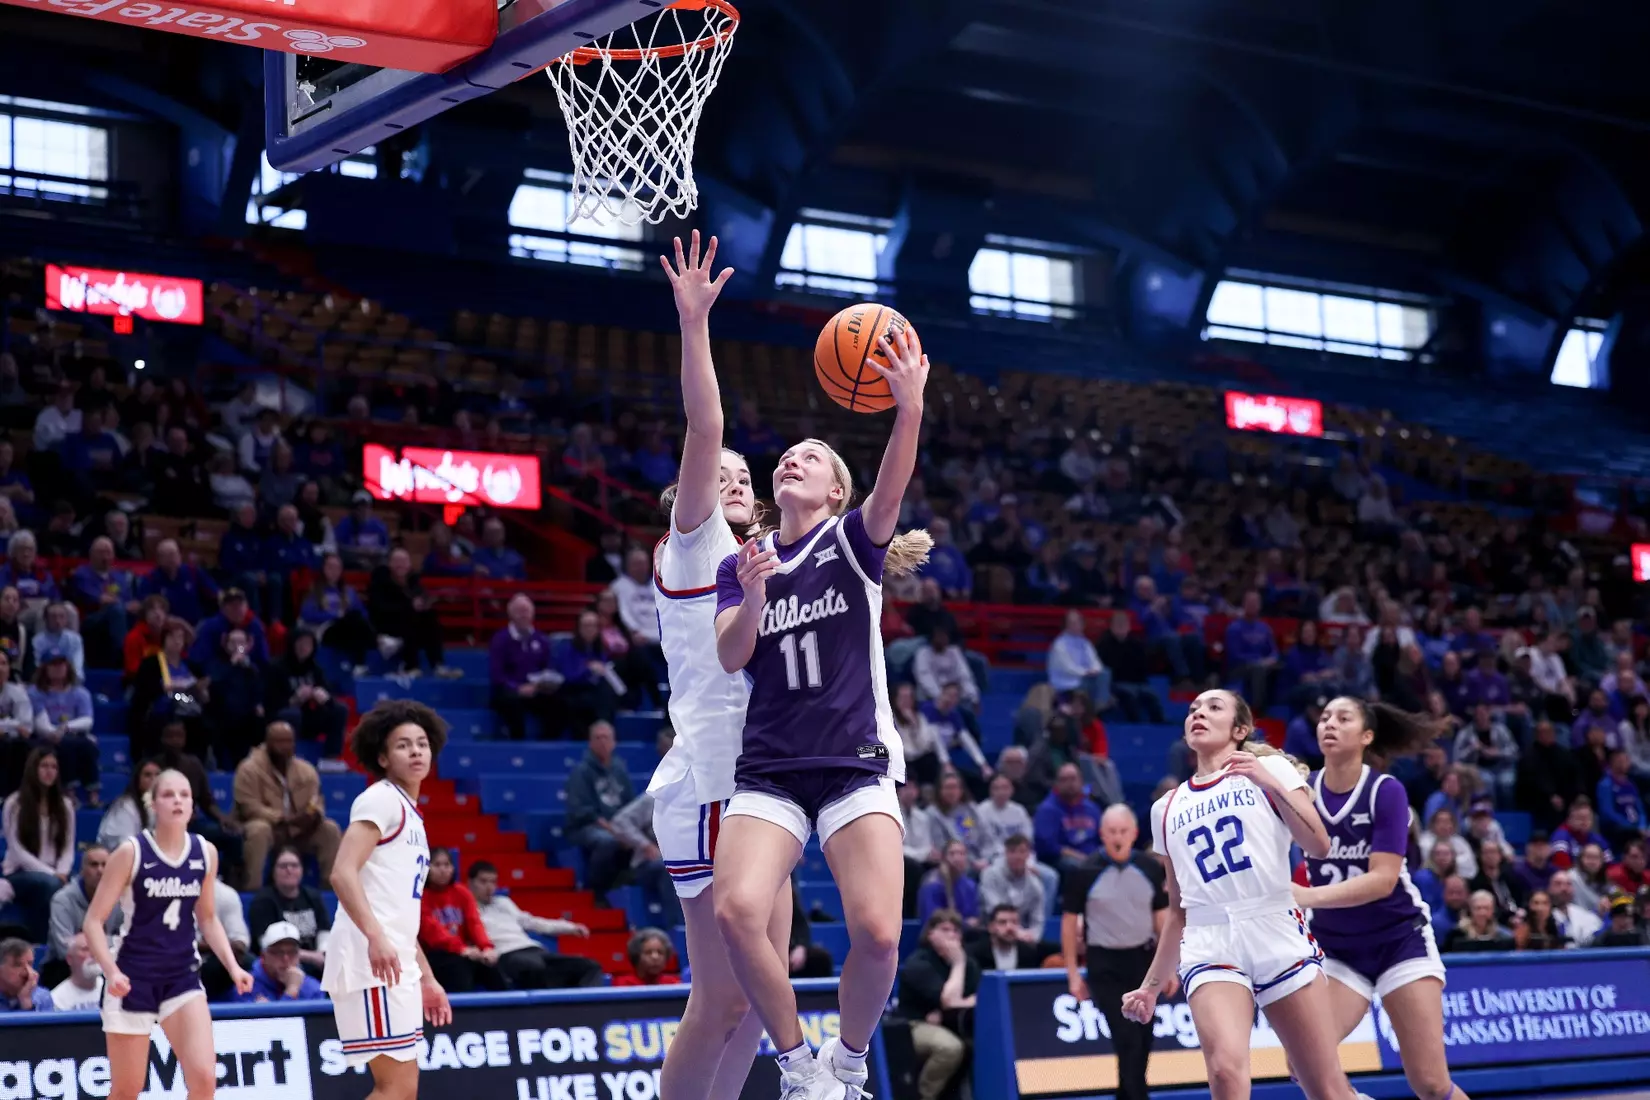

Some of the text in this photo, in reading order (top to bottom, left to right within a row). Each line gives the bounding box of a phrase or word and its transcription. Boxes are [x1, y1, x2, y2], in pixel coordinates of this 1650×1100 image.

[779, 630, 823, 690] 11
[1171, 788, 1256, 834] JAYHAWKS
[1186, 814, 1253, 883] 22
[162, 898, 182, 931] 4
[1442, 982, 1618, 1018] HE UNIVERSITY OF
[516, 1025, 599, 1064] FOR
[1513, 1012, 1591, 1043] HEALTH
[0, 1056, 112, 1100] age
[516, 1069, 661, 1100] LIKE YO
